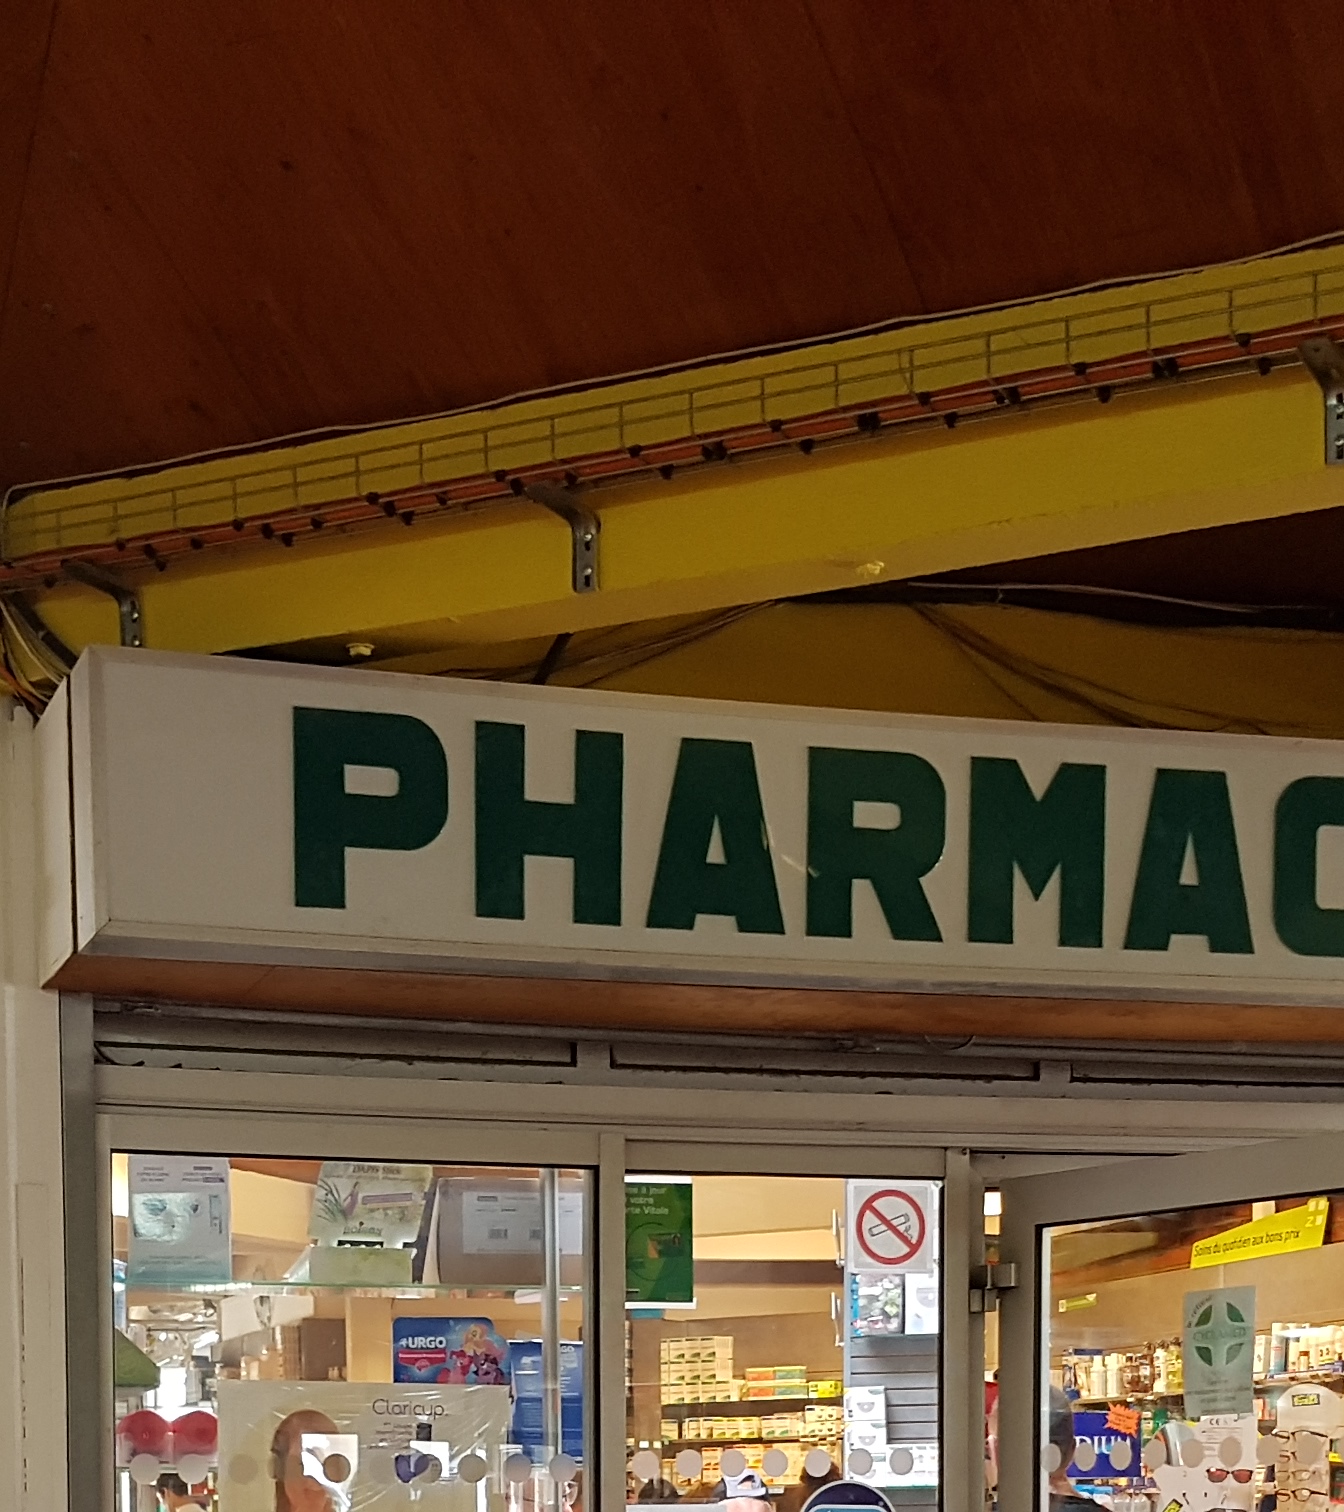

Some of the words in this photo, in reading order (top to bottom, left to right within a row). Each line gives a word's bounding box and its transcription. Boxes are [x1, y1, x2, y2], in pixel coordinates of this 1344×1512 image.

[1194, 1241, 1212, 1257] Soins
[1213, 1239, 1222, 1253] du
[1222, 1236, 1251, 1254] quotidien
[1251, 1235, 1265, 1247] aux
[1265, 1232, 1283, 1244] bons
[1283, 1229, 1301, 1244] prix
[408, 1336, 447, 1349] URGO
[372, 1398, 445, 1420] Claricup
